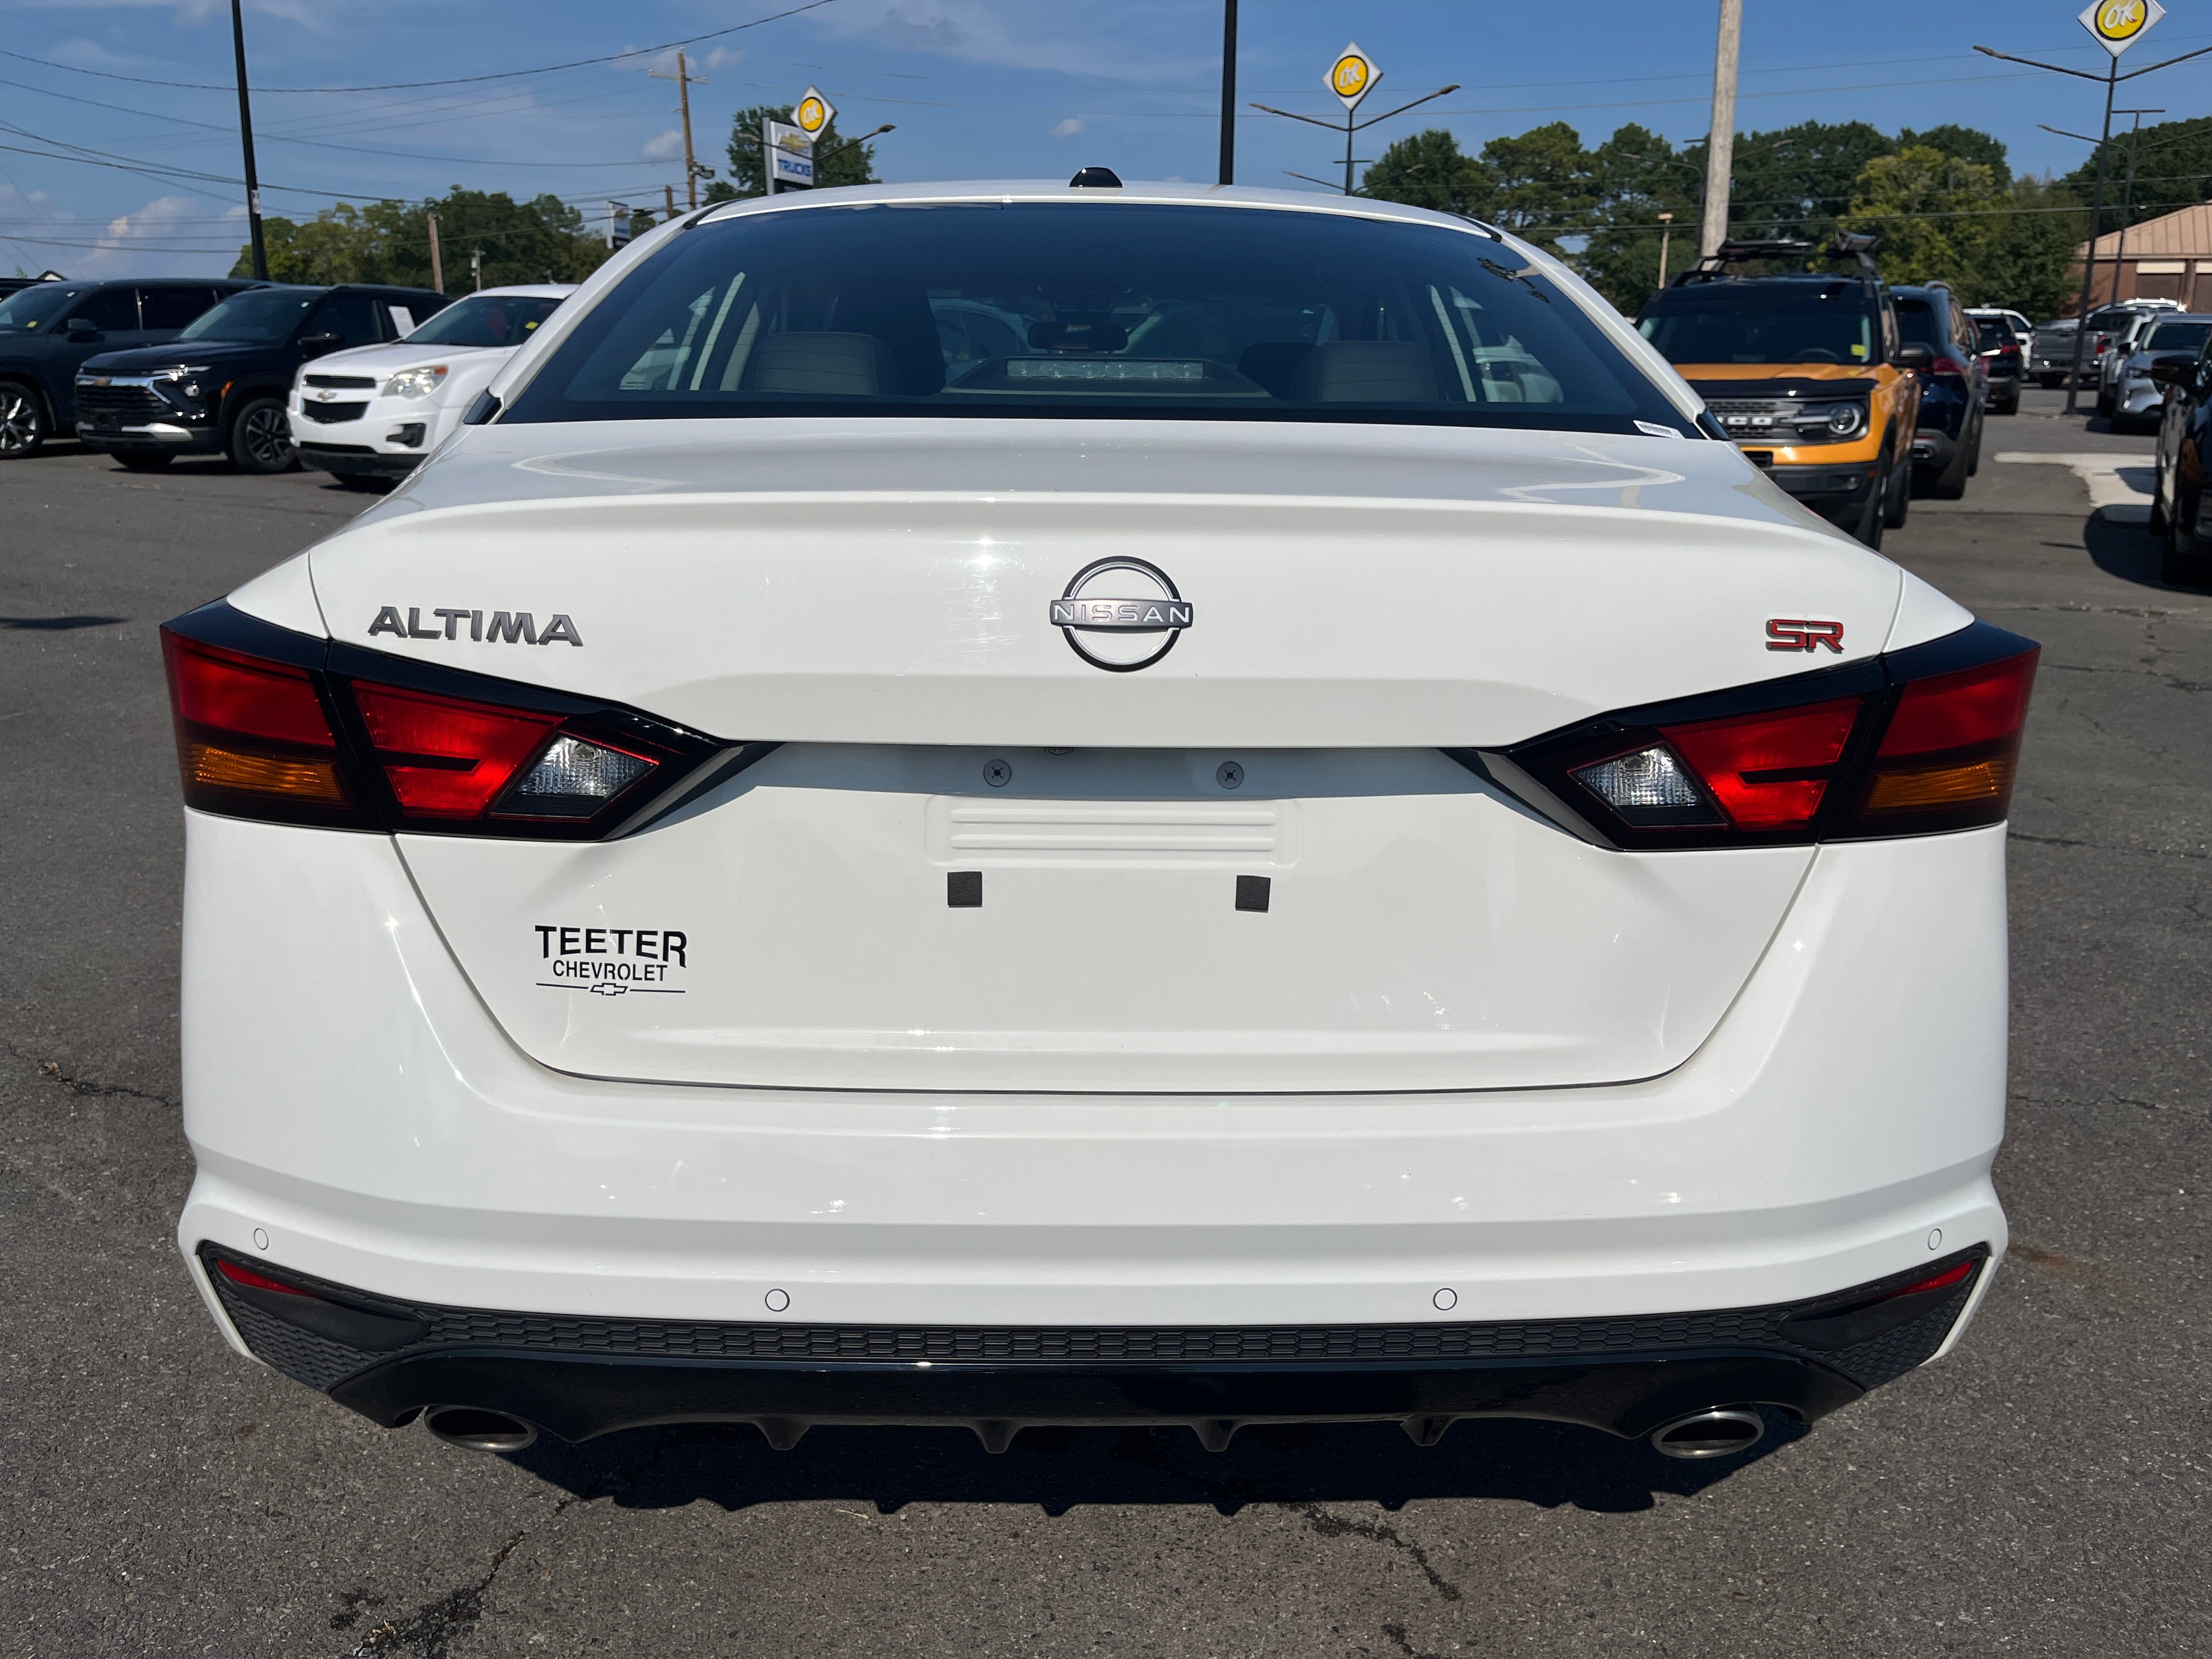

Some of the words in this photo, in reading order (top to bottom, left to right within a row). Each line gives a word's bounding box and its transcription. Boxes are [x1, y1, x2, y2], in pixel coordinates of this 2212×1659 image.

[2104, 0, 2138, 29] OK
[1339, 61, 1363, 87] OK
[803, 101, 822, 124] OK
[778, 159, 812, 177] TRUCKS
[1716, 416, 1773, 426] CO
[1053, 604, 1190, 623] NISSAN
[368, 606, 584, 647] ALTIMA
[1765, 619, 1844, 654] SR
[535, 925, 687, 969] TEETER
[553, 960, 668, 981] CHEVROLET
